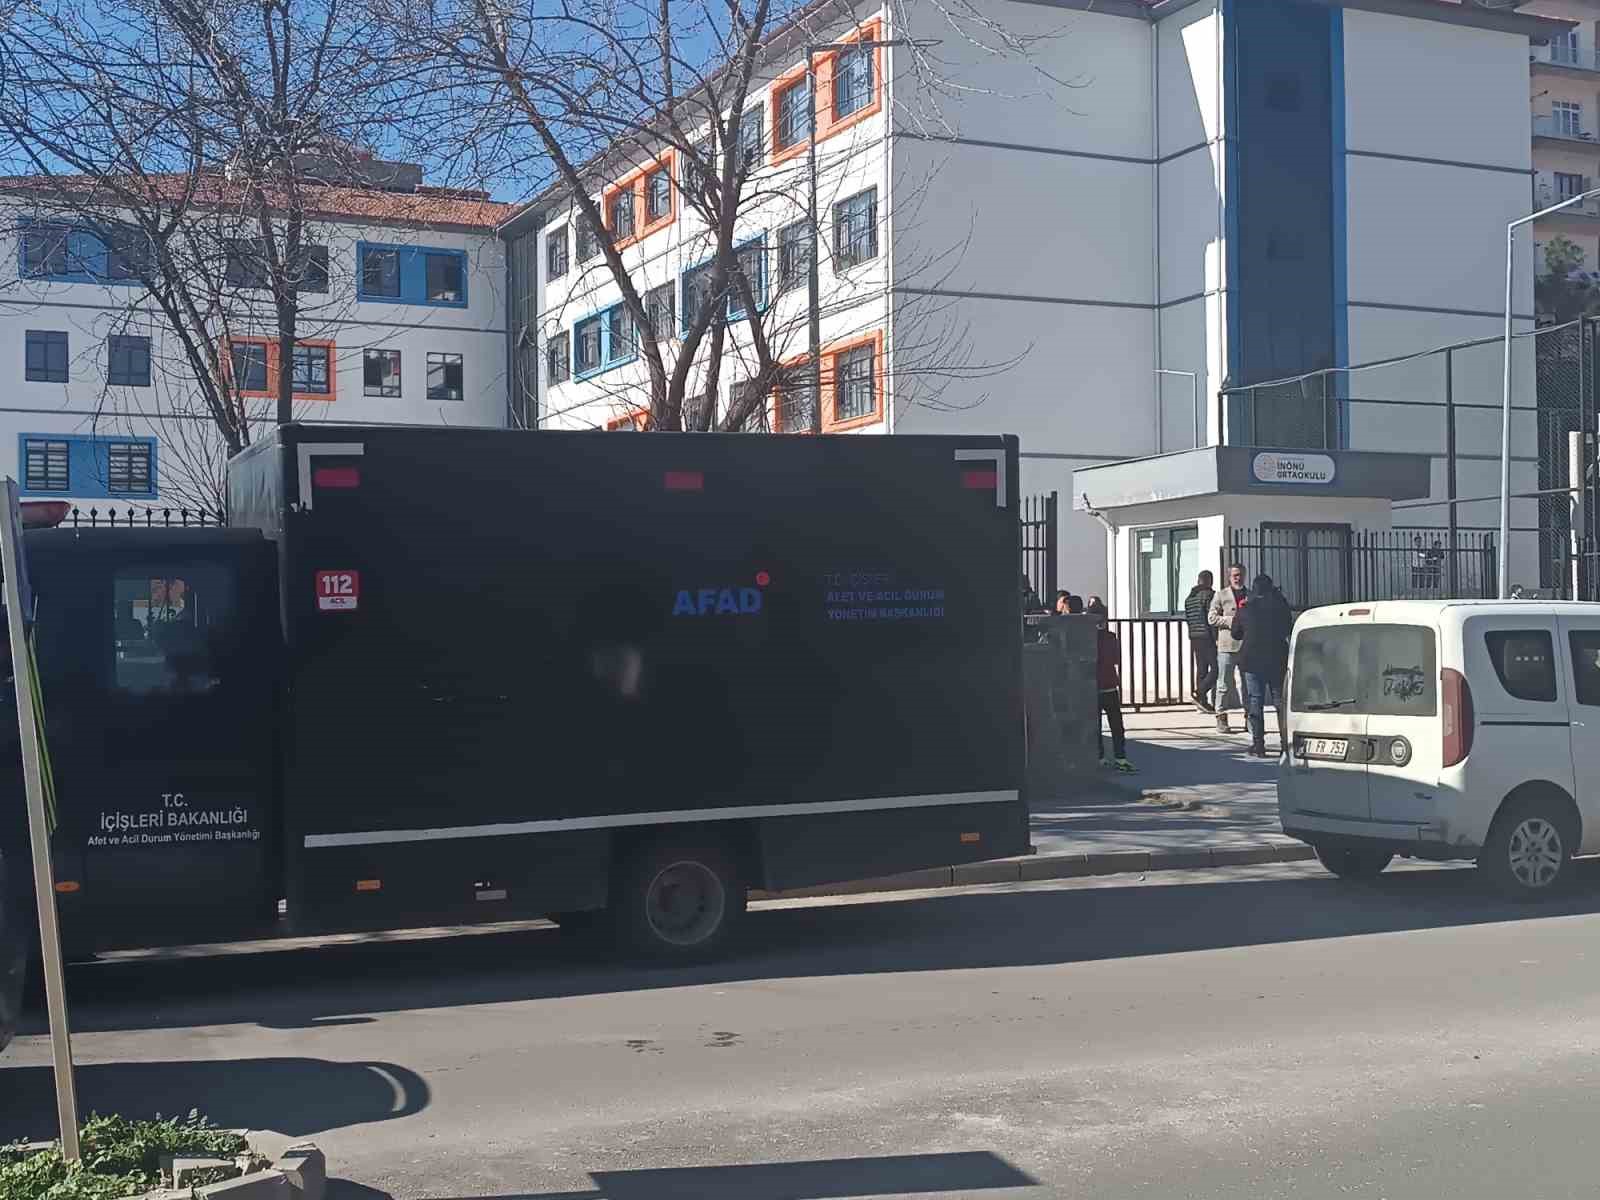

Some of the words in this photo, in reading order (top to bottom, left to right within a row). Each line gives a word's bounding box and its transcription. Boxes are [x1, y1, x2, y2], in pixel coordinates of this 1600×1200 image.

[1276, 471, 1326, 480] ORTAOKULU
[322, 574, 353, 594] 112
[671, 587, 764, 616] AFAD
[1315, 740, 1326, 753] FR
[161, 793, 188, 808] T.C.
[100, 809, 164, 832] İÇİŞLERİ
[167, 806, 248, 826] BAKANLIĞI
[87, 835, 108, 846] Afet
[108, 837, 120, 845] ve
[121, 834, 139, 844] Acil
[141, 833, 172, 843] Durum
[174, 831, 213, 842] Yönetimi
[215, 828, 261, 841] Başkanlığı
